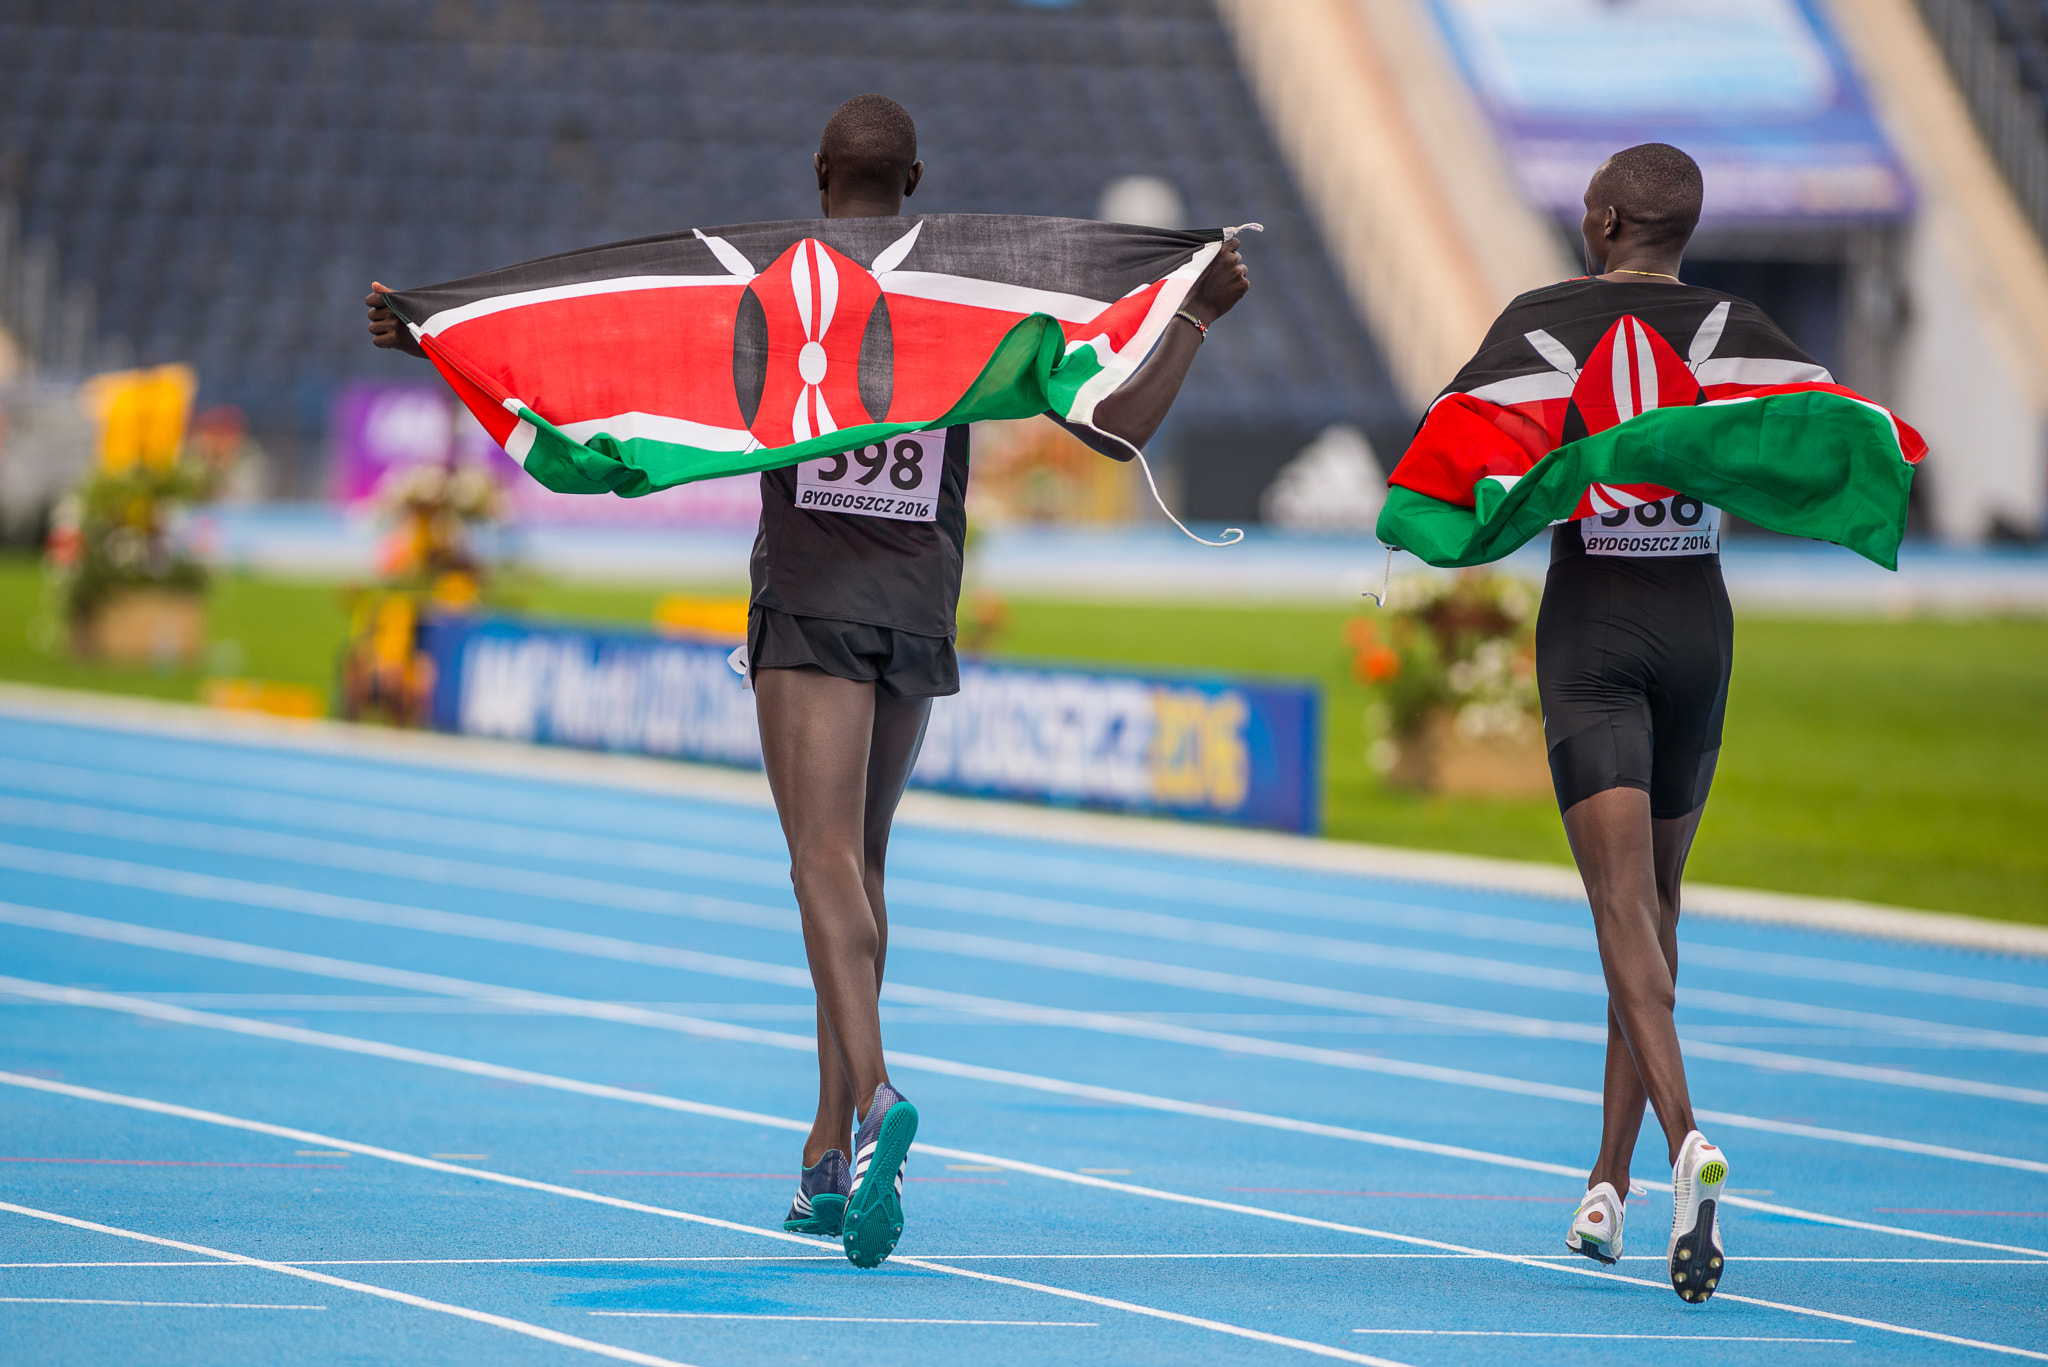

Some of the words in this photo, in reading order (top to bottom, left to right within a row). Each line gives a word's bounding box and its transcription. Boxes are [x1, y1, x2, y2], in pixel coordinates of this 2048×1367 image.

[801, 490, 895, 513] BYDGOSZCZ
[895, 501, 931, 517] 2016
[1586, 537, 1680, 552] BYDGOSZCZ
[1681, 536, 1710, 551] 2016
